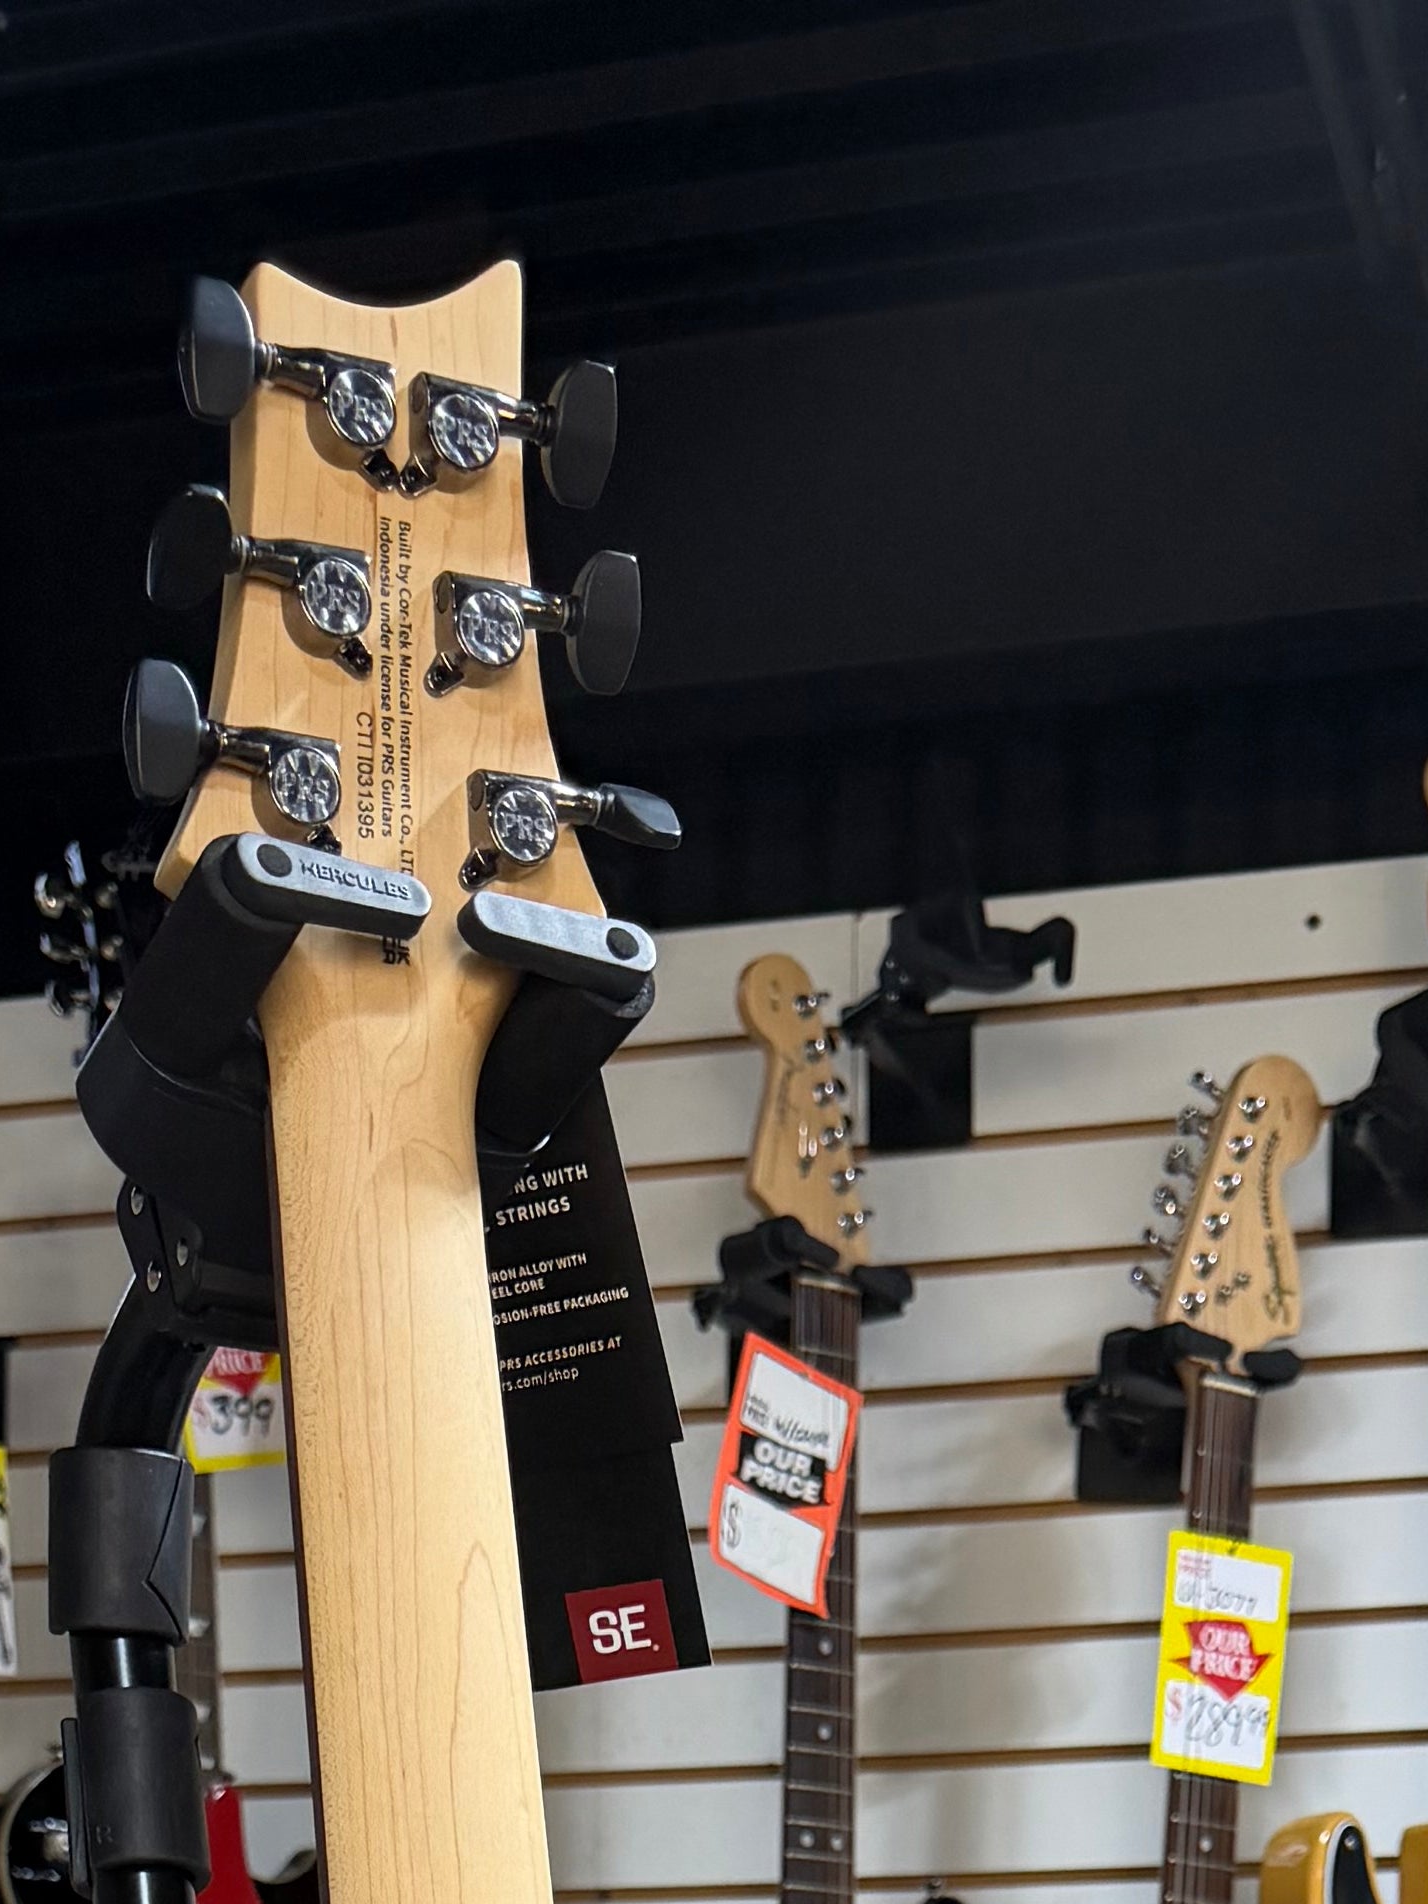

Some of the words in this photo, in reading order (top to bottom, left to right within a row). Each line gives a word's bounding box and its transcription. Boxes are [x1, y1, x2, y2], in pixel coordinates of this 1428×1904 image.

[379, 517, 391, 596] Indonesia
[398, 521, 411, 559] Built
[395, 564, 410, 582] by
[380, 601, 391, 651] under
[398, 587, 413, 649] Cor-Tek
[380, 655, 392, 711] license
[399, 655, 413, 709] Musical
[381, 713, 394, 738] for
[382, 743, 394, 772] PRS
[399, 712, 414, 813] Instrument
[381, 775, 394, 838] Guitars
[542, 1164, 589, 1188] WITH
[495, 1196, 571, 1226] STRINGS
[518, 1259, 554, 1278] ALLOY
[555, 1253, 587, 1270] WITH
[491, 1286, 513, 1300] EEL
[514, 1277, 546, 1295] CORE
[493, 1300, 562, 1326] OSION-FREE
[563, 1287, 629, 1311] PACKAGING
[499, 1357, 522, 1373] PRS
[524, 1339, 604, 1368] ACCESSORIES
[607, 1336, 622, 1350] AT
[501, 1367, 580, 1393] rs.com/shop
[754, 1437, 813, 1478] OUR
[739, 1458, 821, 1505] PRICE
[1199, 1624, 1251, 1656] OUR
[1190, 1649, 1257, 1682] PRICE
